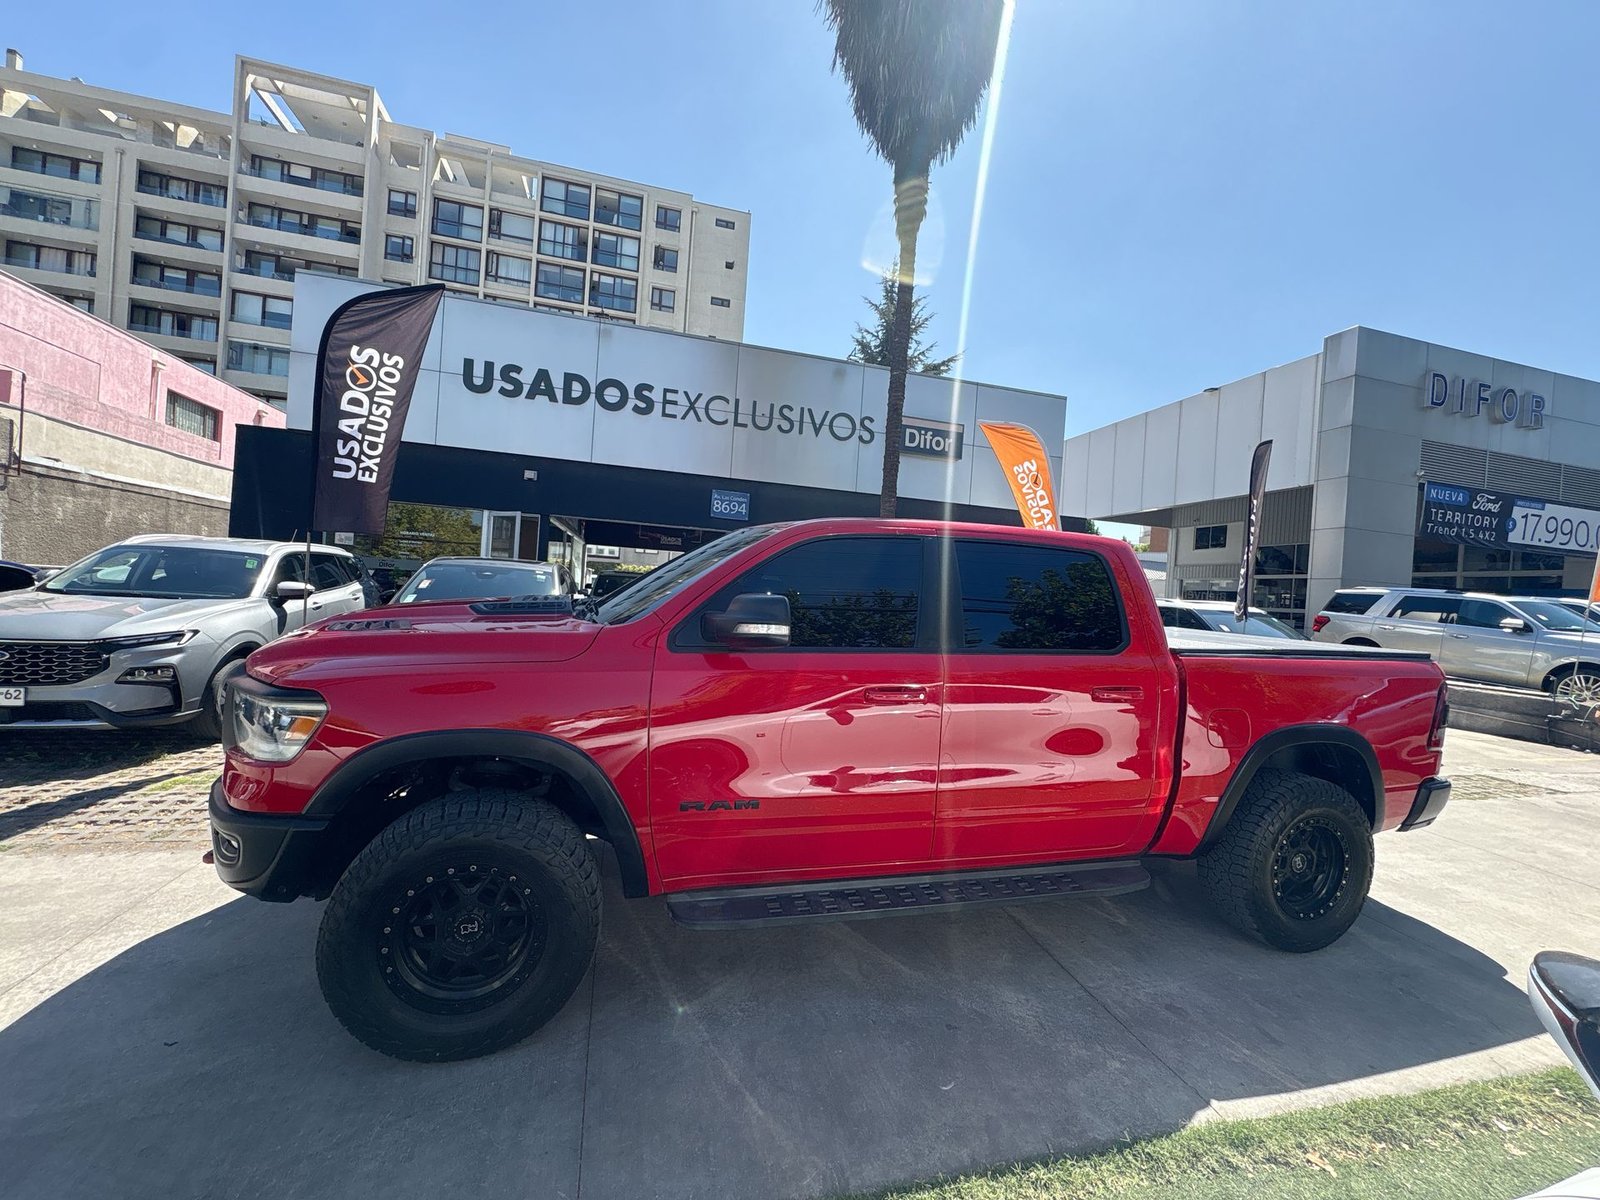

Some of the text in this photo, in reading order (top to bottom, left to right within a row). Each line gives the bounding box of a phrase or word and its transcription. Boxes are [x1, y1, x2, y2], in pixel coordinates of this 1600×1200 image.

[1427, 372, 1546, 428] DIFOR
[332, 345, 381, 480] USADOS
[357, 352, 405, 483] EXCLUSIVOS
[904, 428, 953, 452] Difor
[1430, 488, 1464, 503] NUEVA
[1472, 493, 1502, 513] Ford
[713, 500, 747, 515] 8694
[1431, 508, 1499, 529] TERRITORY
[1426, 523, 1497, 542] Trend 1.5 4X2
[680, 800, 760, 811] RAM
